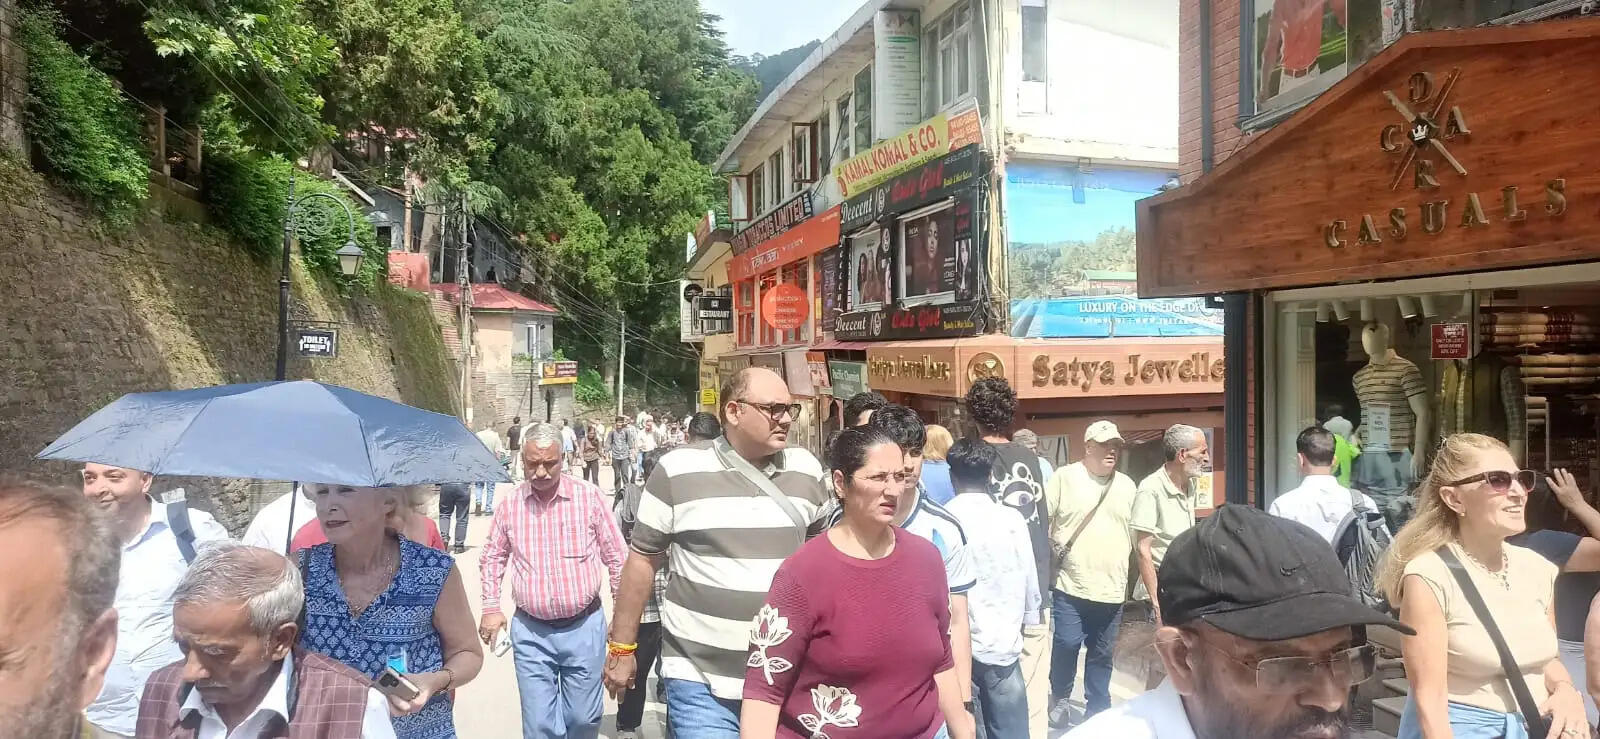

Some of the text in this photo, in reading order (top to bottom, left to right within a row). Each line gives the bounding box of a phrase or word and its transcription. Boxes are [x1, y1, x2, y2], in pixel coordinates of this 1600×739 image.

[843, 155, 873, 184] KAMAL
[871, 138, 908, 171] KOMAL
[907, 132, 919, 157] &
[918, 124, 941, 152] CO.
[773, 196, 804, 232] LIMITED
[1326, 178, 1567, 248] CASUALS
[834, 316, 866, 332] Deecent
[1080, 302, 1117, 313] LUXURY
[1121, 301, 1136, 313] ON
[1140, 301, 1158, 313] THE
[1162, 302, 1185, 313] EDGE
[1032, 352, 1225, 393] Satya Jewelle
